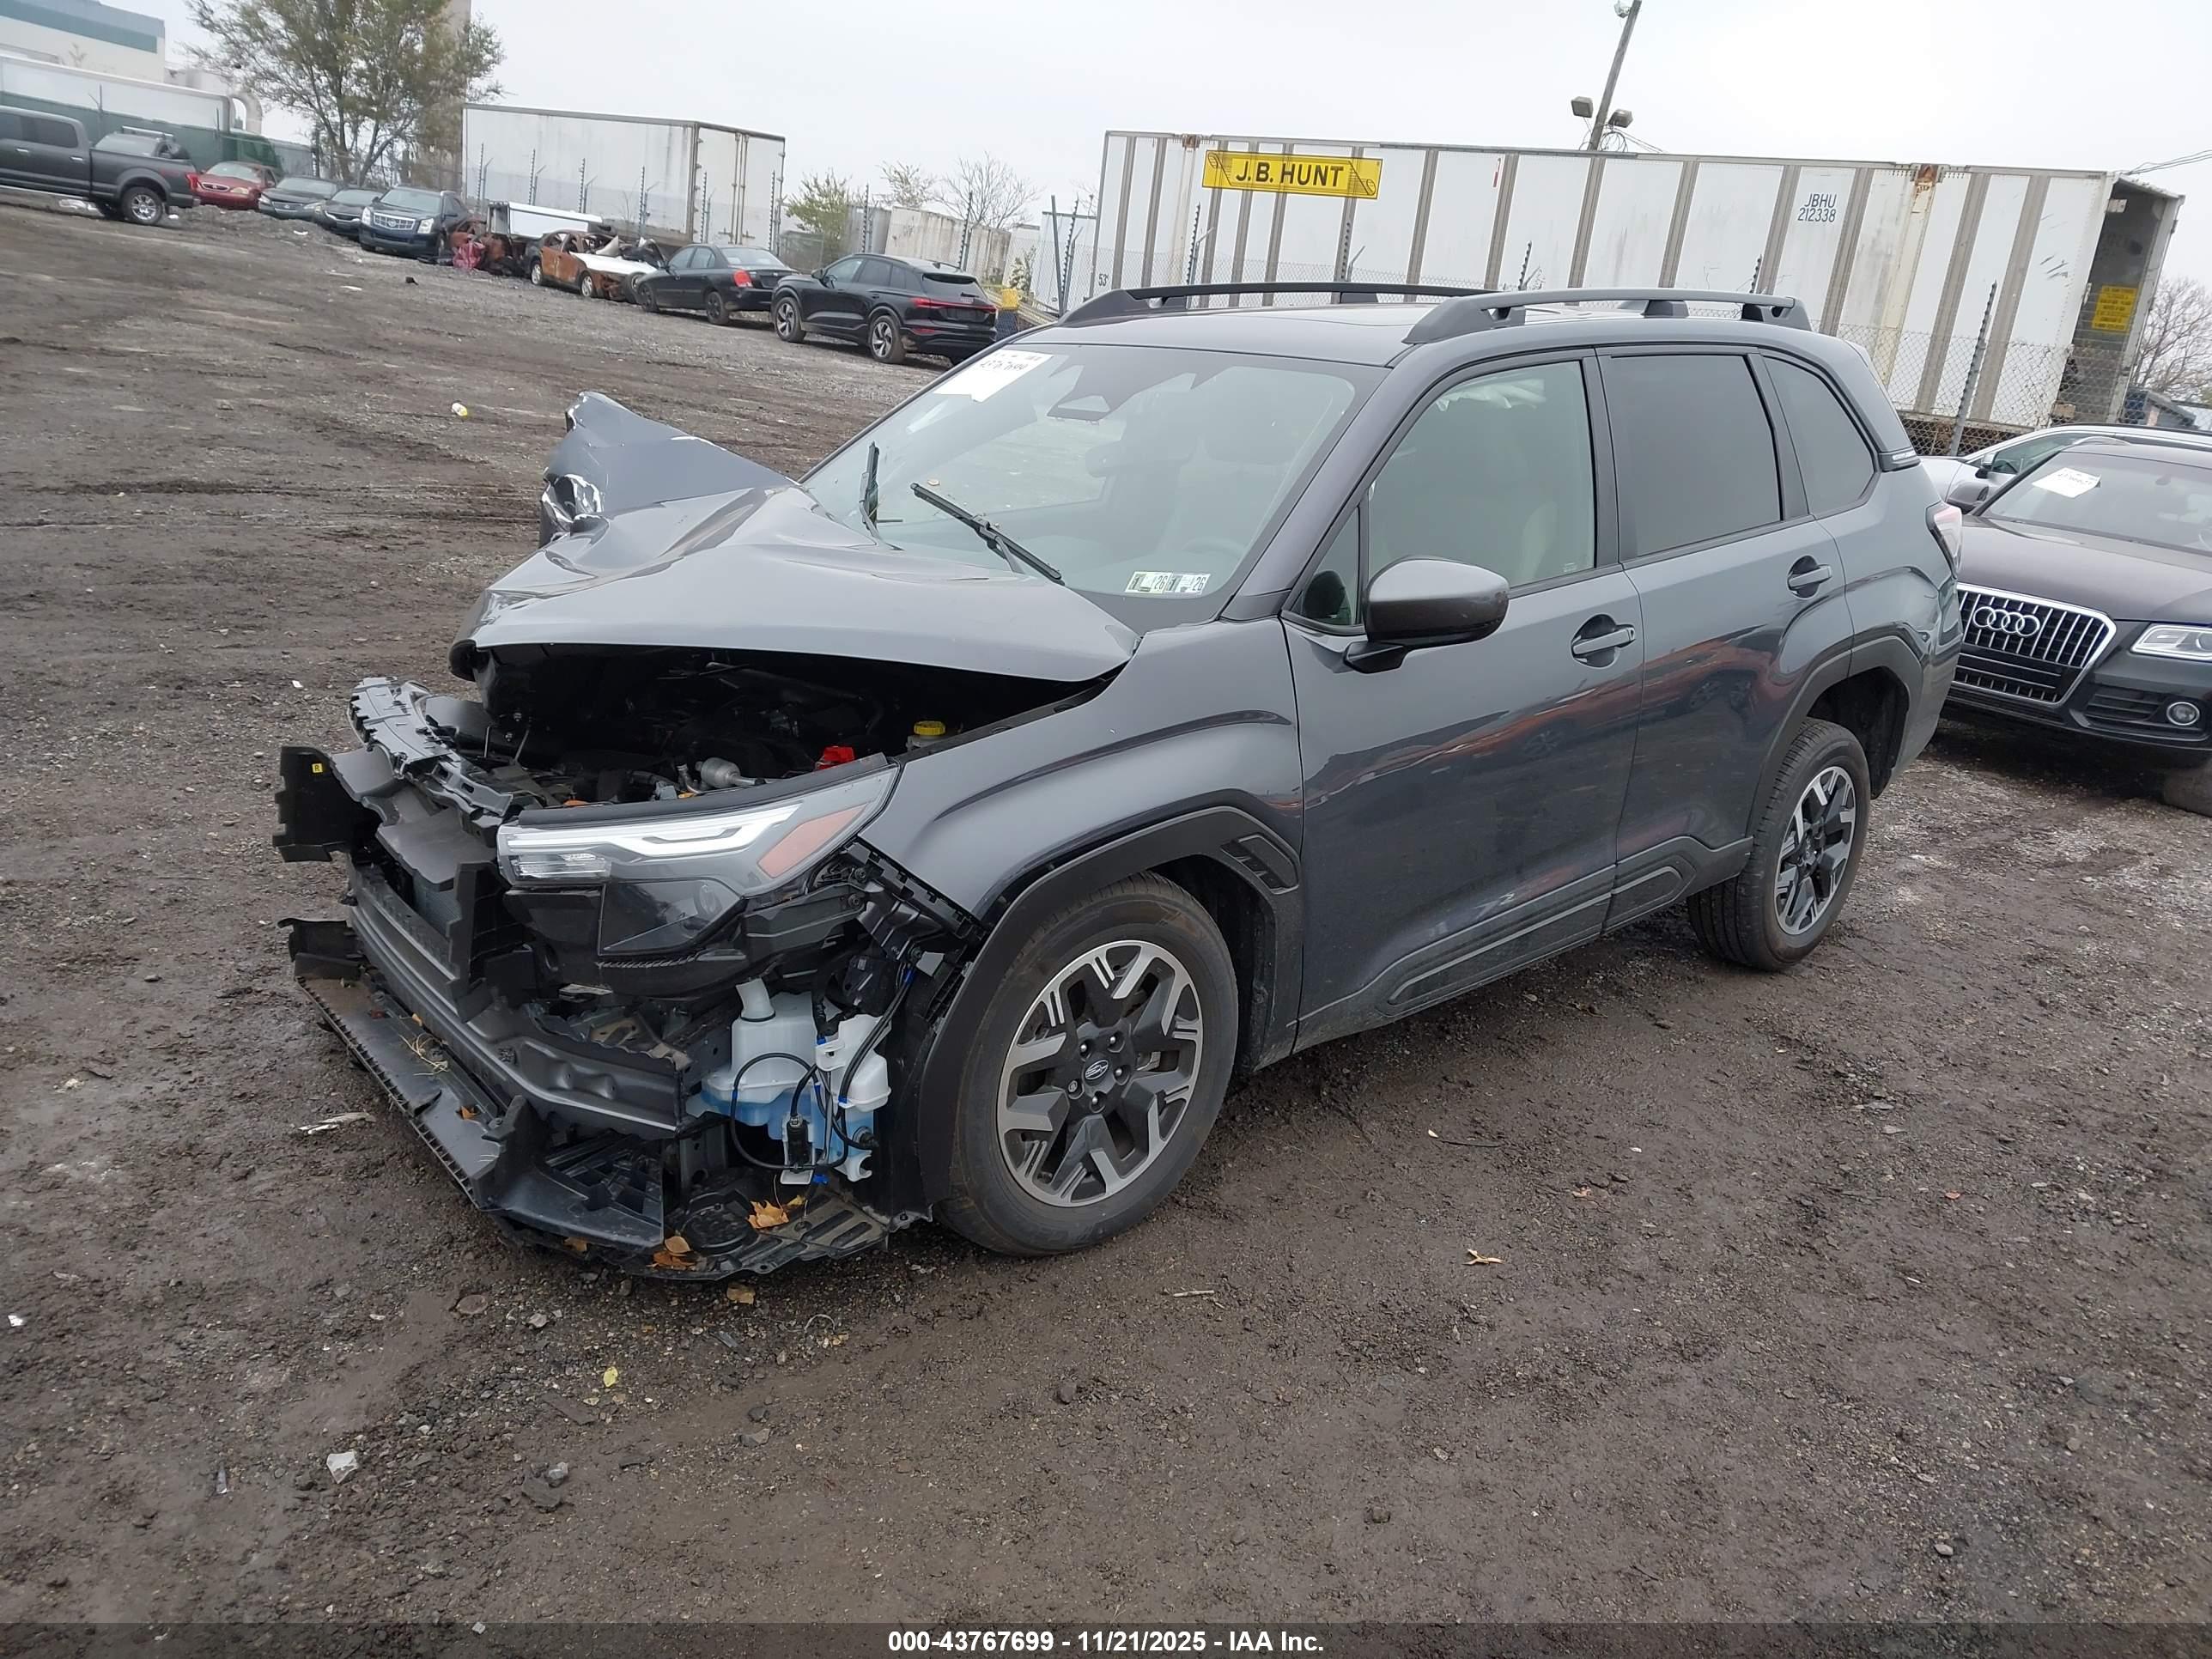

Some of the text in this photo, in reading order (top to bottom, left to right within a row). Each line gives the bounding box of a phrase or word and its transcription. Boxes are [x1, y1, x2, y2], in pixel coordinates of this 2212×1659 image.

[1236, 161, 1345, 187] J.B. HUNT
[1803, 192, 1838, 209] JBHU
[1797, 207, 1838, 222] 212338
[1192, 576, 1207, 591] 26
